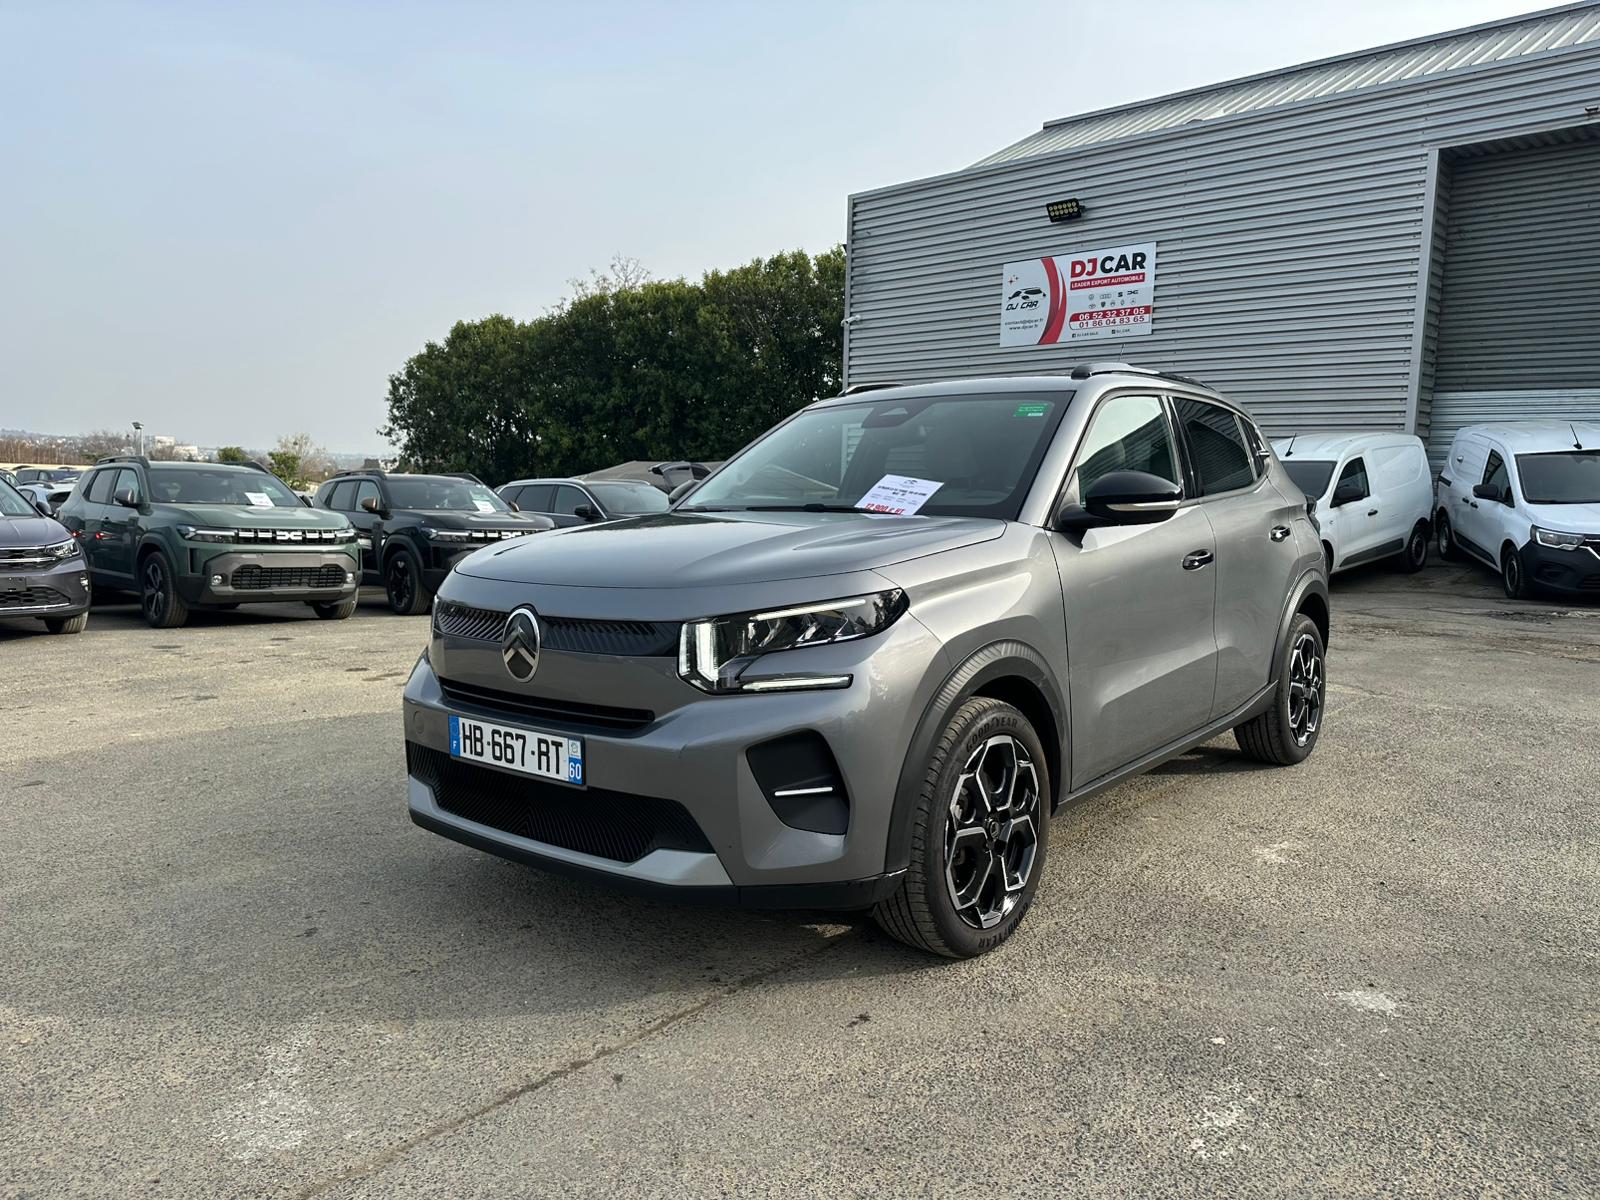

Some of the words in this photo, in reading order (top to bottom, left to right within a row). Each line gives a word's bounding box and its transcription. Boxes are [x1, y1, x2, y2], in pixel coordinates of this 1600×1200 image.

[1070, 257, 1098, 278] DJ
[1100, 252, 1147, 274] CAR
[1071, 281, 1091, 289] LEADER
[1091, 278, 1111, 286] EXPORT
[1111, 274, 1143, 284] AUTOMOBILE
[1005, 302, 1019, 311] DJ
[1020, 300, 1039, 309] CAR
[1105, 310, 1117, 318] 32
[1120, 308, 1131, 316] 37
[1133, 307, 1145, 315] 05
[1079, 321, 1089, 329] 01
[1092, 319, 1103, 327] 86
[1105, 318, 1116, 326] 04
[1133, 315, 1145, 323] 65
[452, 740, 457, 750] F
[569, 762, 582, 780] 60
